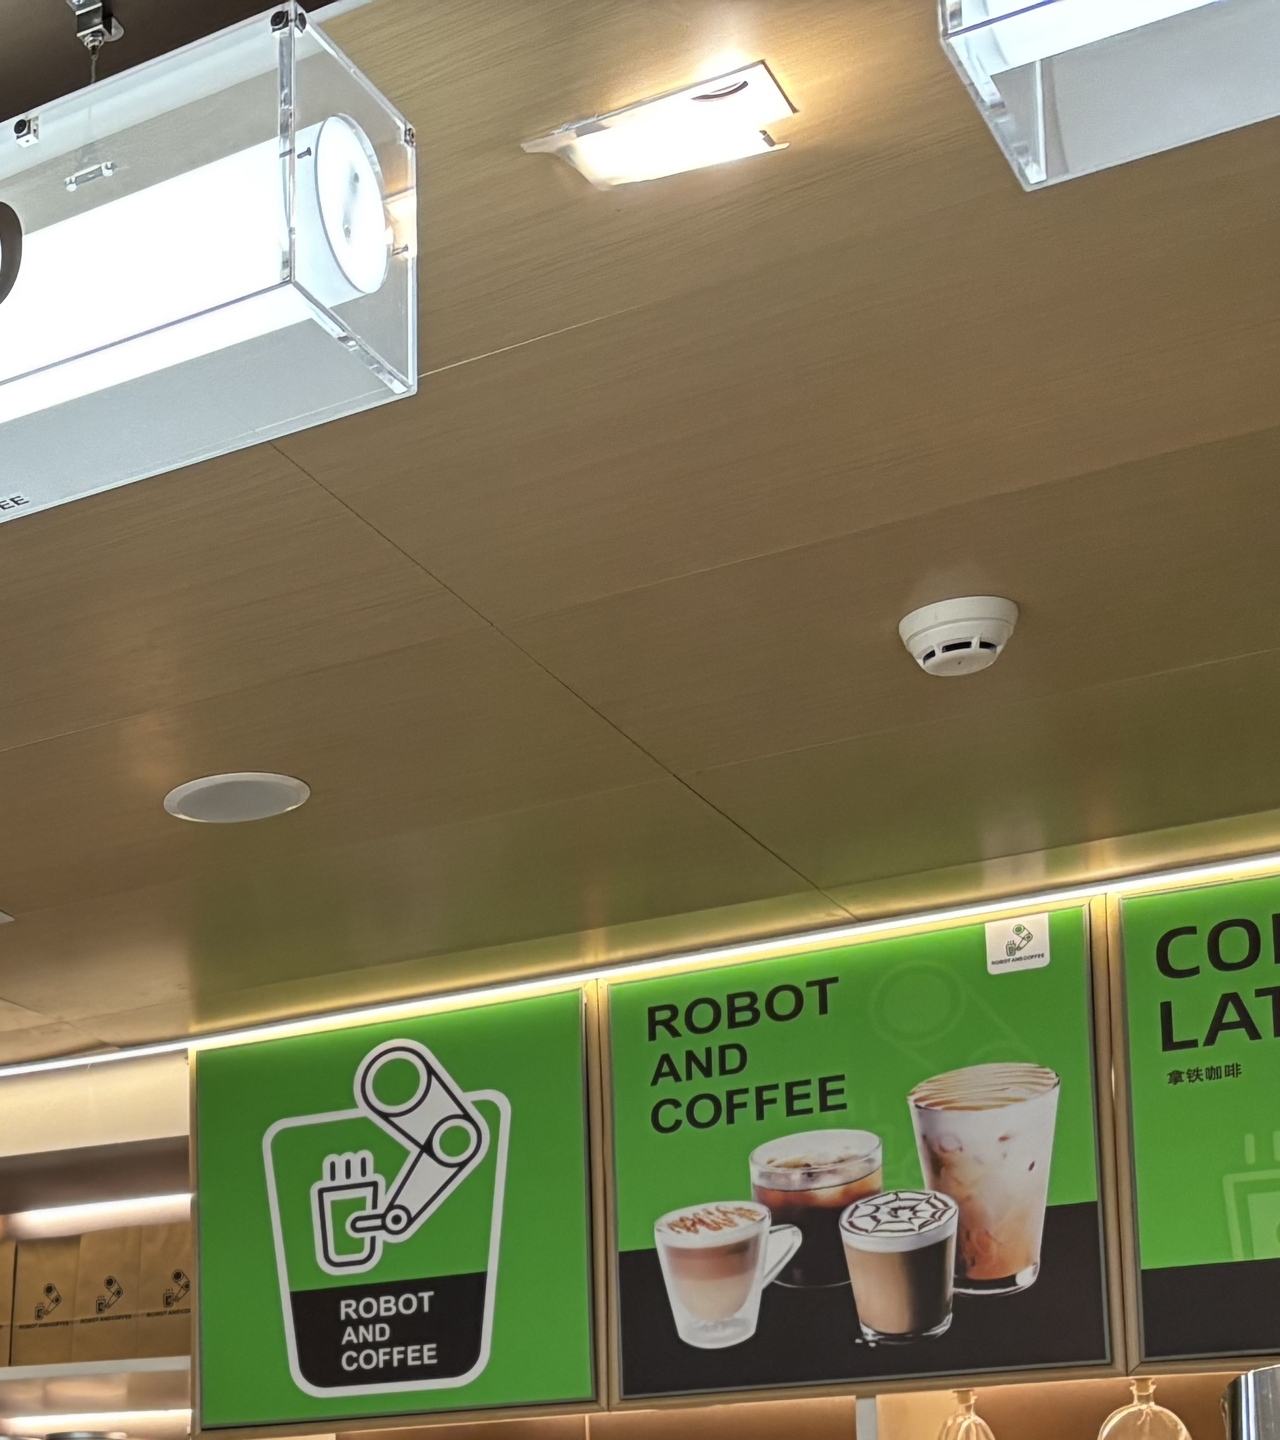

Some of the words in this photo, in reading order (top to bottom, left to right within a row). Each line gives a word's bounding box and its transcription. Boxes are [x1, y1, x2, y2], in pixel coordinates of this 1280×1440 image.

[1156, 913, 1280, 979] CO
[648, 976, 839, 1042] ROBOT
[650, 1043, 748, 1086] AND
[1167, 1062, 1242, 1085] 拿铁咖啡
[651, 1074, 847, 1134] COFFEE
[340, 1291, 434, 1321] ROBOT
[341, 1323, 390, 1345] AND
[341, 1343, 438, 1371] COFFEE
